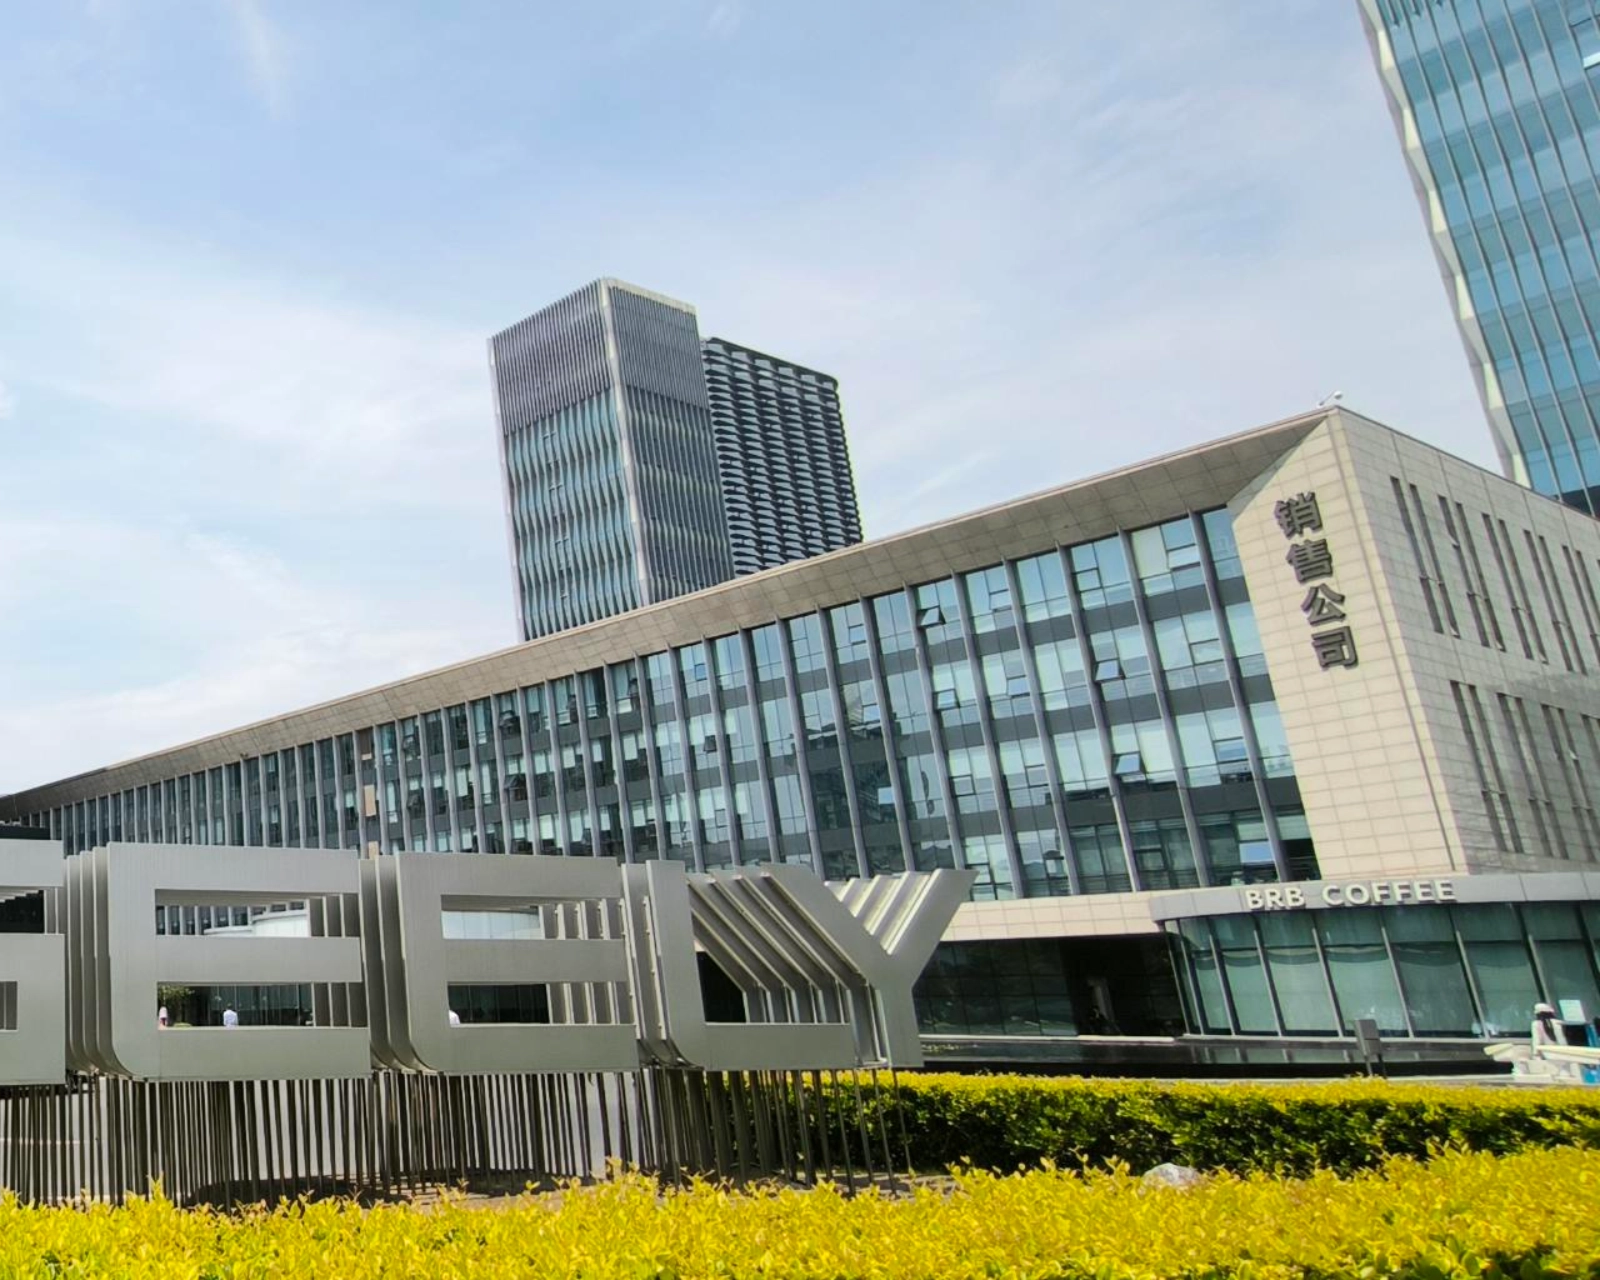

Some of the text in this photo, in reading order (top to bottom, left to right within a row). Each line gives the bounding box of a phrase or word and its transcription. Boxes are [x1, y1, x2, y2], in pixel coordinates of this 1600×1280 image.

[1274, 491, 1359, 671] 销售公司
[1245, 879, 1457, 911] BRB COFFEE
